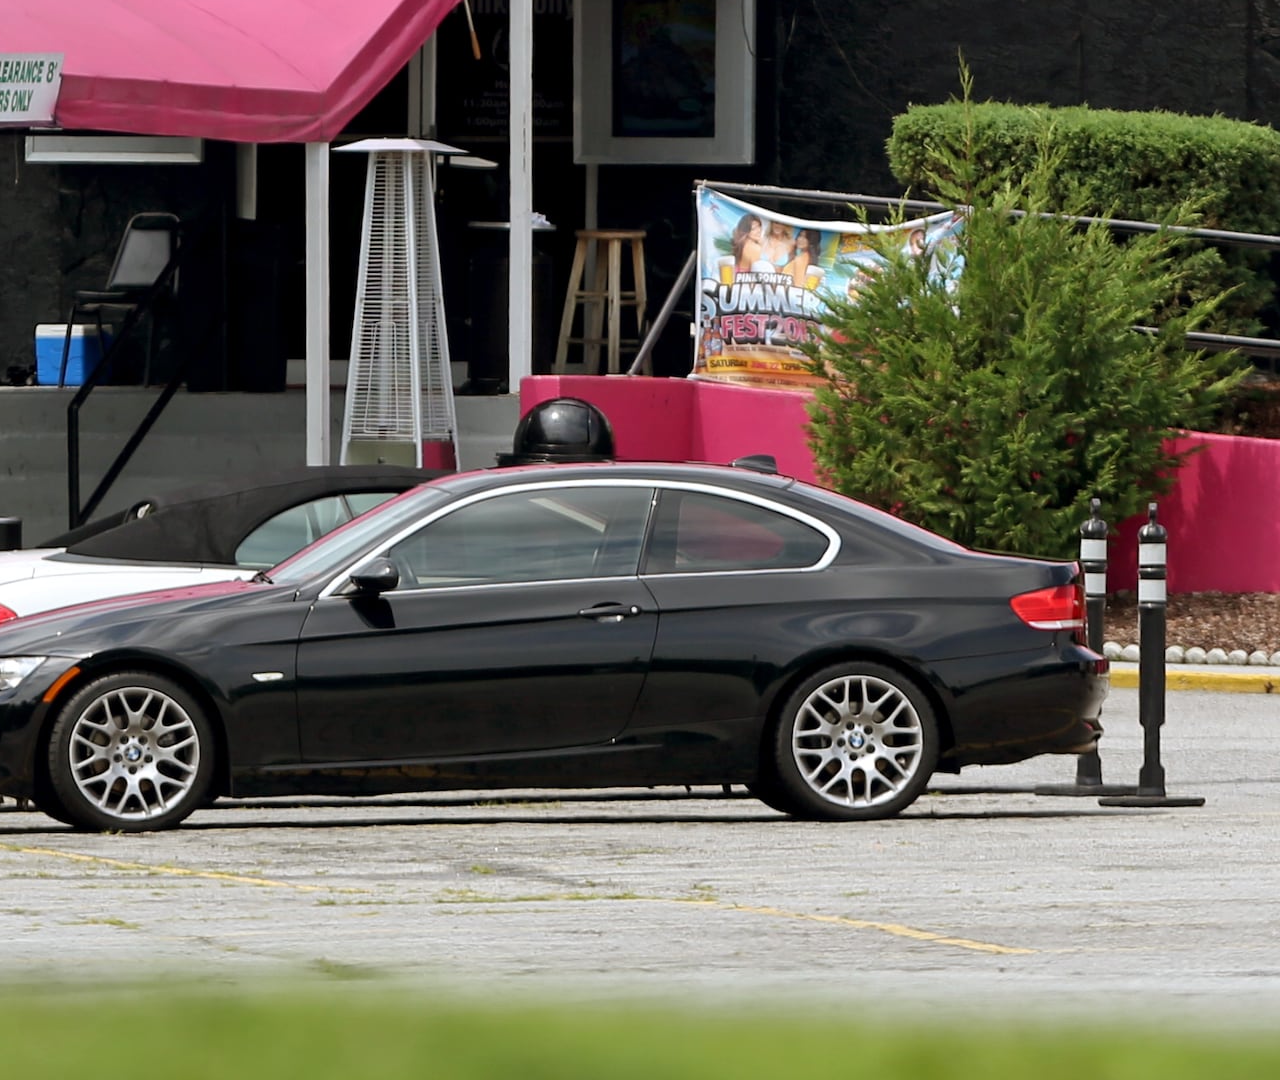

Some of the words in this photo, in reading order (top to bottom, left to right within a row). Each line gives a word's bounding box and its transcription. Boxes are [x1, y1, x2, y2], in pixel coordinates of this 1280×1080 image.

[11, 89, 34, 112] ONLY
[701, 278, 821, 321] SUMMER
[721, 314, 767, 339] FEST
